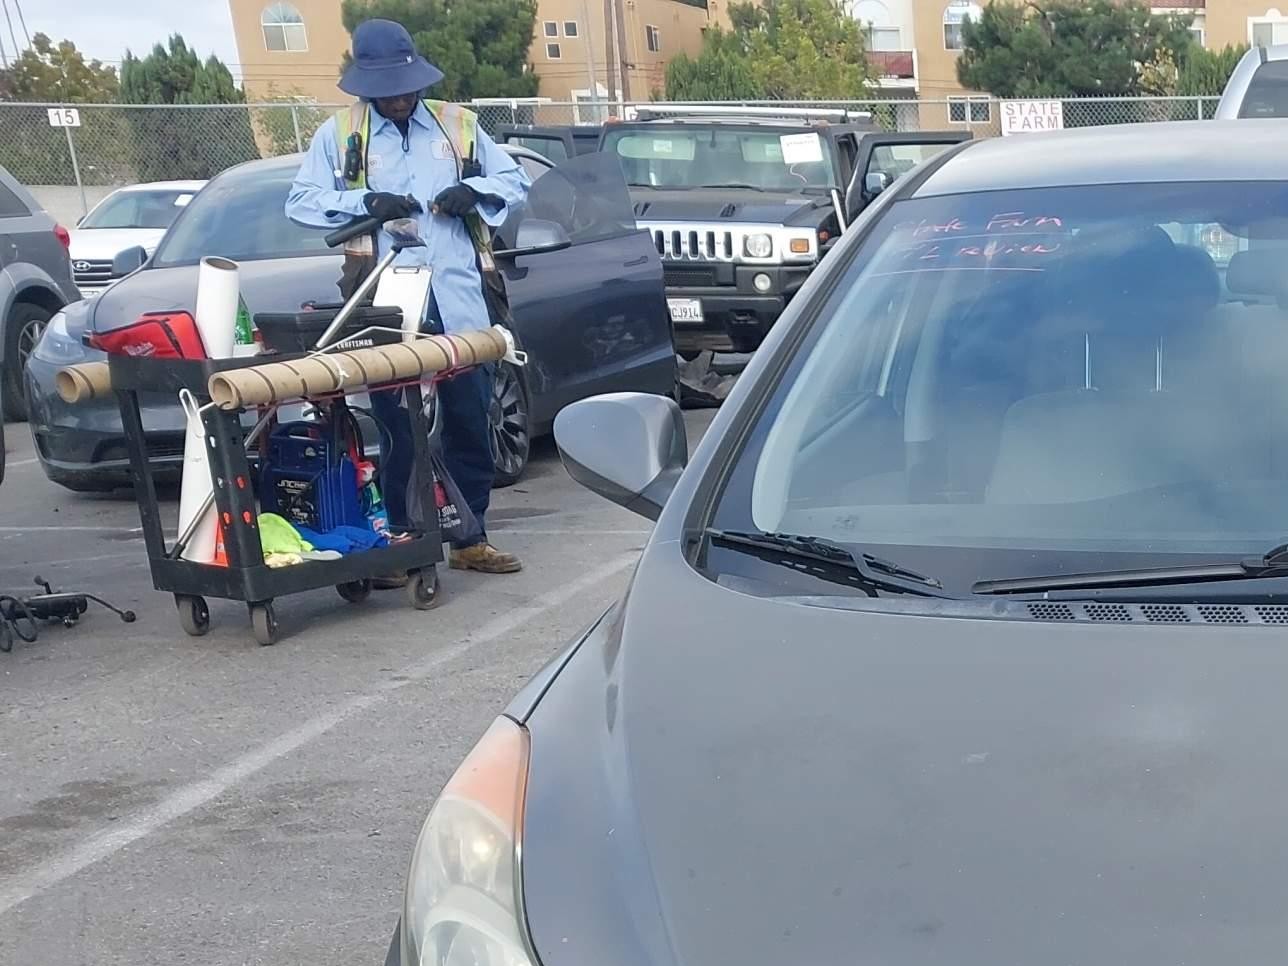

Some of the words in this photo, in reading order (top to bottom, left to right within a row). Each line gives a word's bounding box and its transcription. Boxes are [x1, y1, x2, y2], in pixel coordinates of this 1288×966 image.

[1005, 102, 1060, 116] STATE
[53, 109, 74, 125] 15
[1008, 115, 1059, 129] FARM
